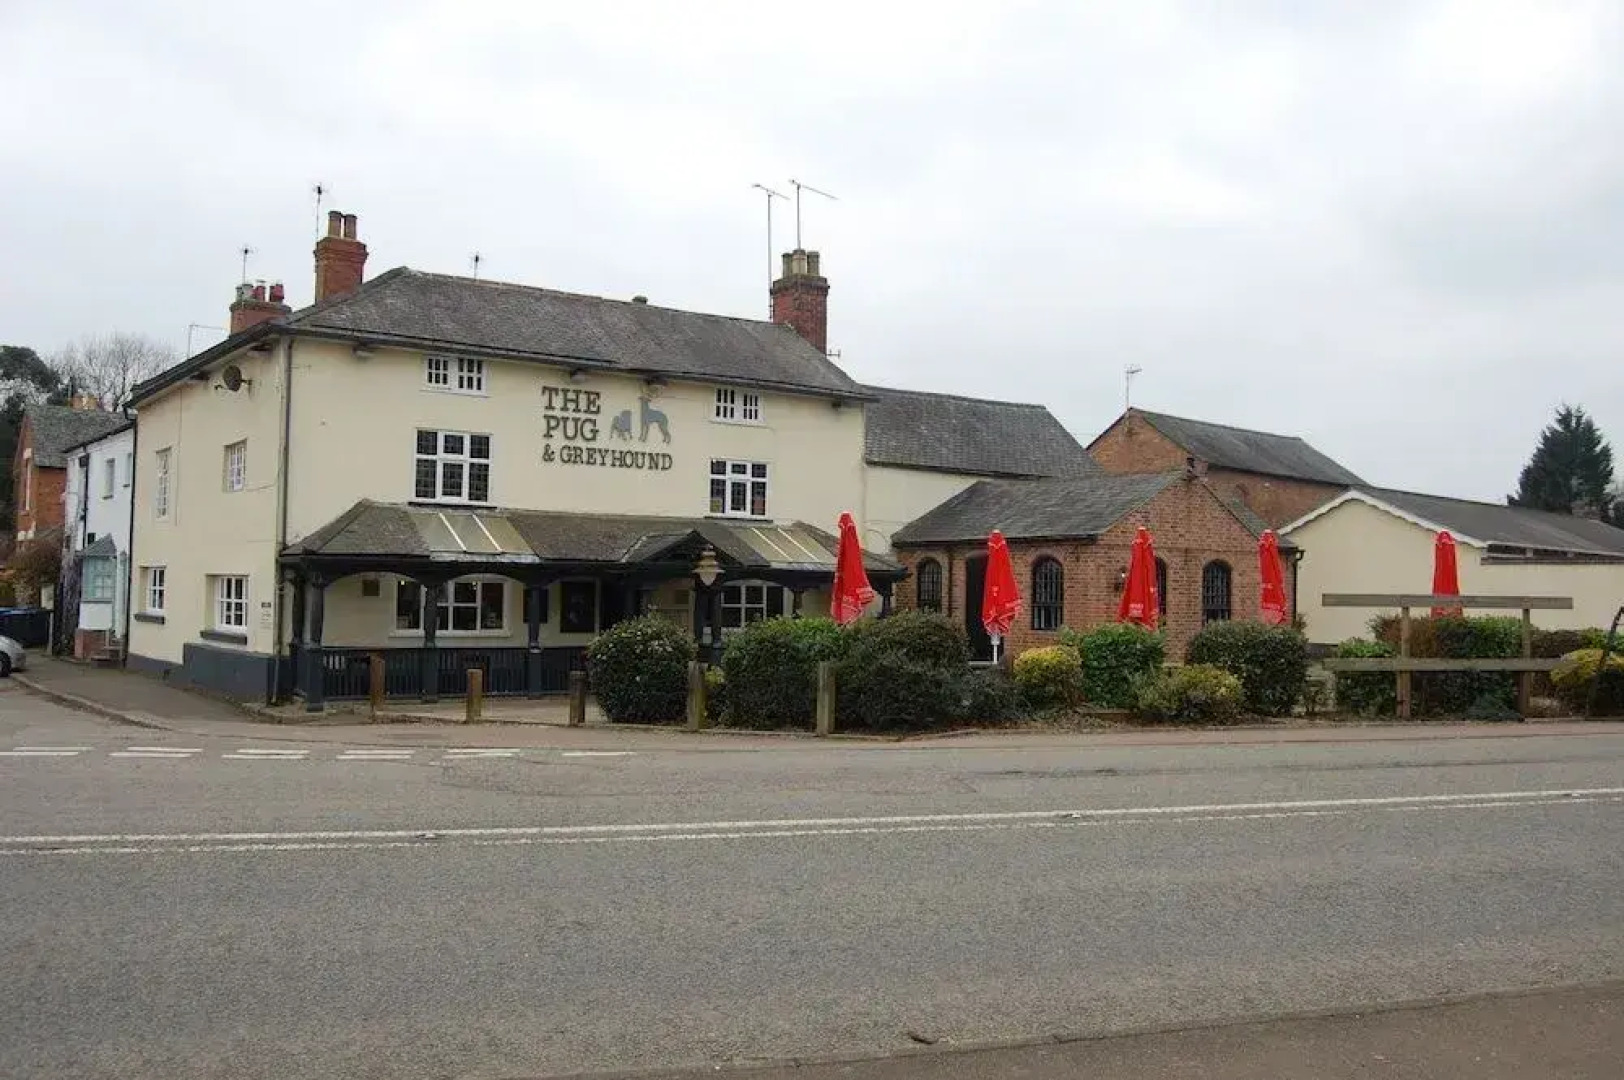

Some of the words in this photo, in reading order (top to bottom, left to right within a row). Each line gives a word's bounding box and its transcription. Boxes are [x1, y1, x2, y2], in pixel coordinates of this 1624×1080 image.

[542, 386, 601, 415] THE
[543, 415, 599, 442] PUG
[542, 443, 555, 462] &
[560, 445, 673, 471] GREYHOUND
